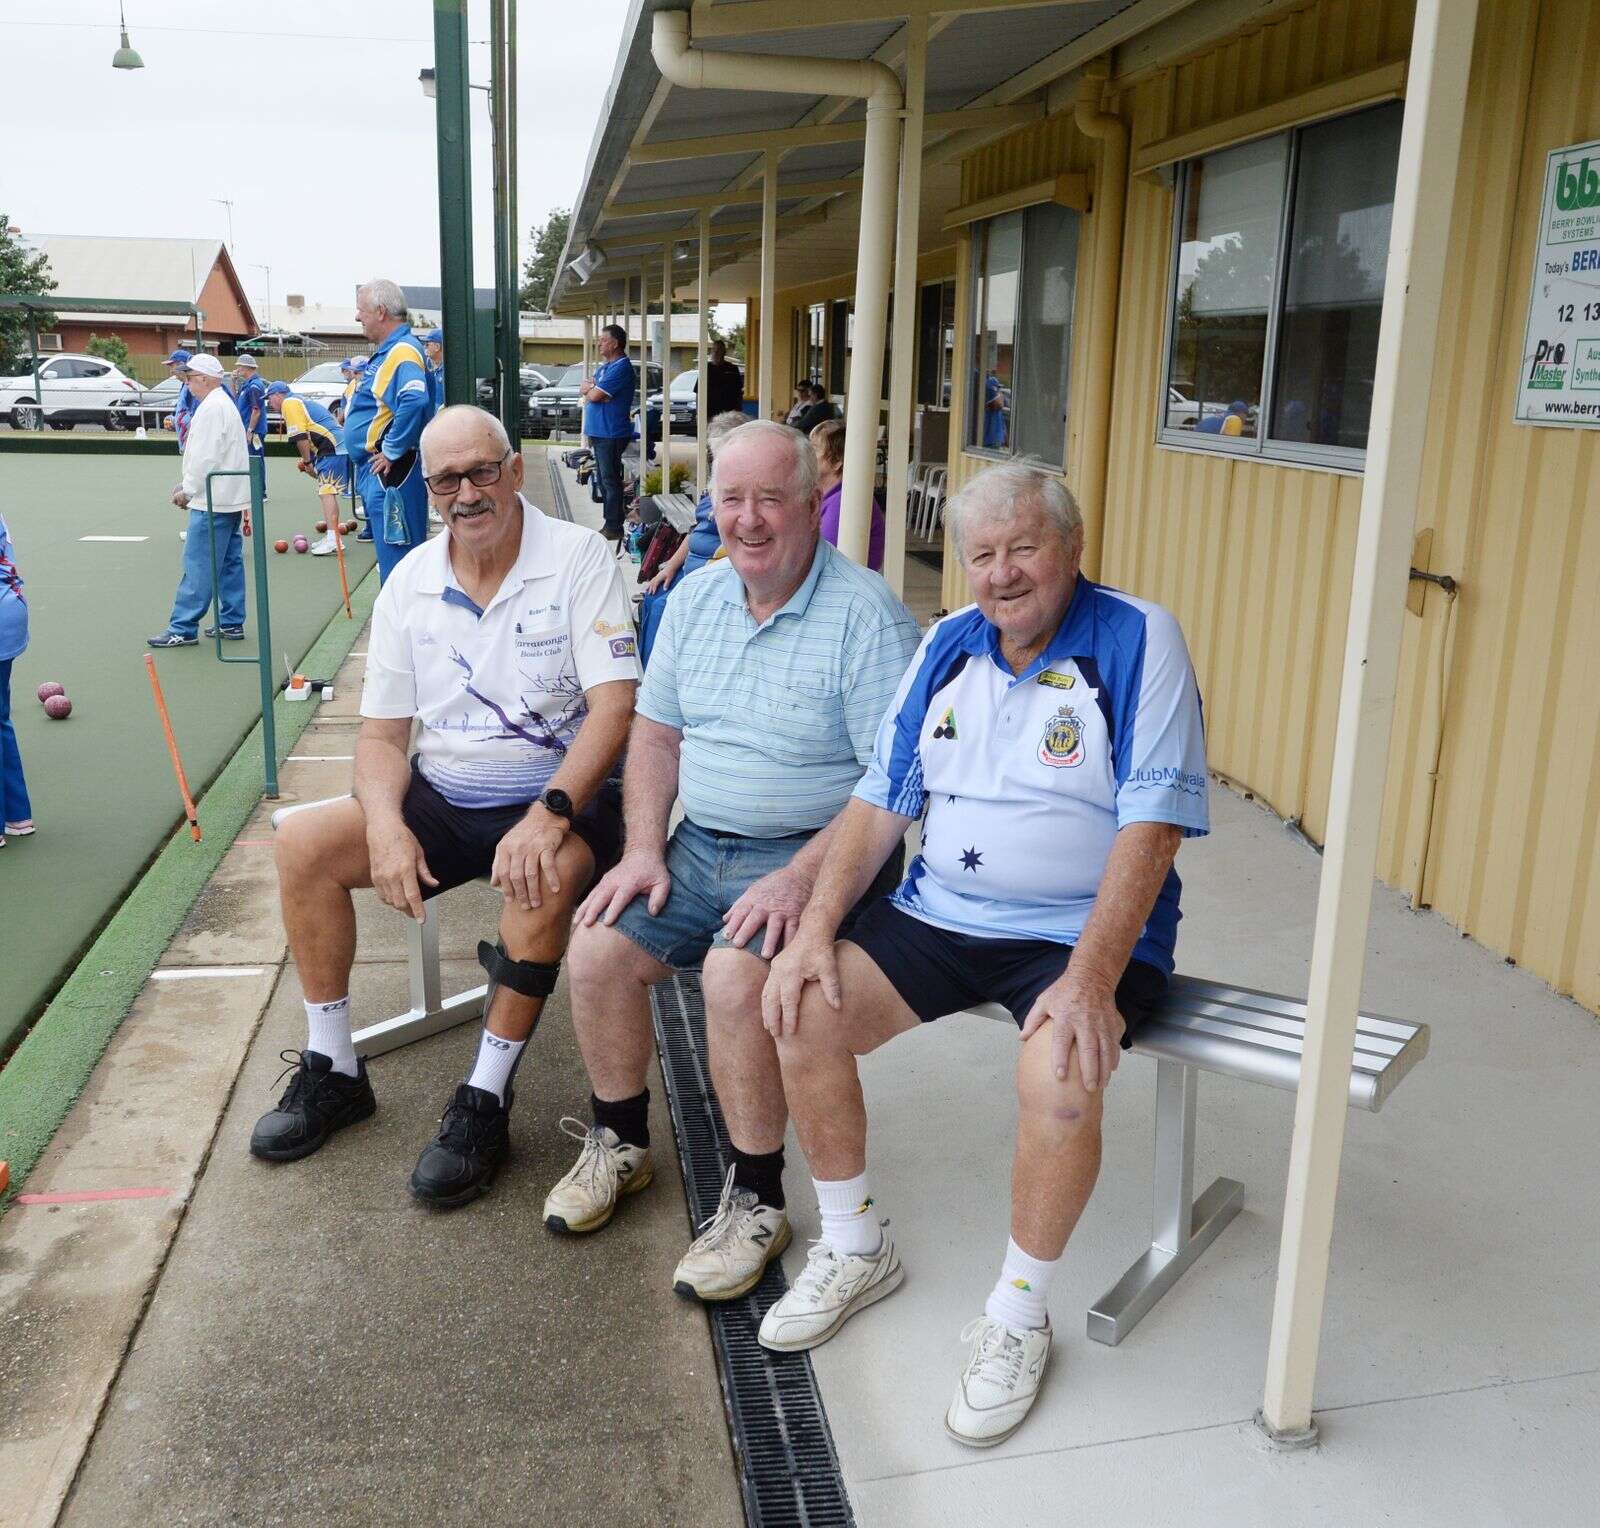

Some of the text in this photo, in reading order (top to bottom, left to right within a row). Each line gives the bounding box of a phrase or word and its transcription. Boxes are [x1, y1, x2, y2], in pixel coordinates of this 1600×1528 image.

[1551, 217, 1575, 230] BERRY
[1562, 227, 1594, 240] SYSTEMS
[1545, 262, 1569, 275] Today's
[1558, 303, 1600, 322] 12 13
[1534, 364, 1567, 382] Master
[544, 647, 562, 657] Club
